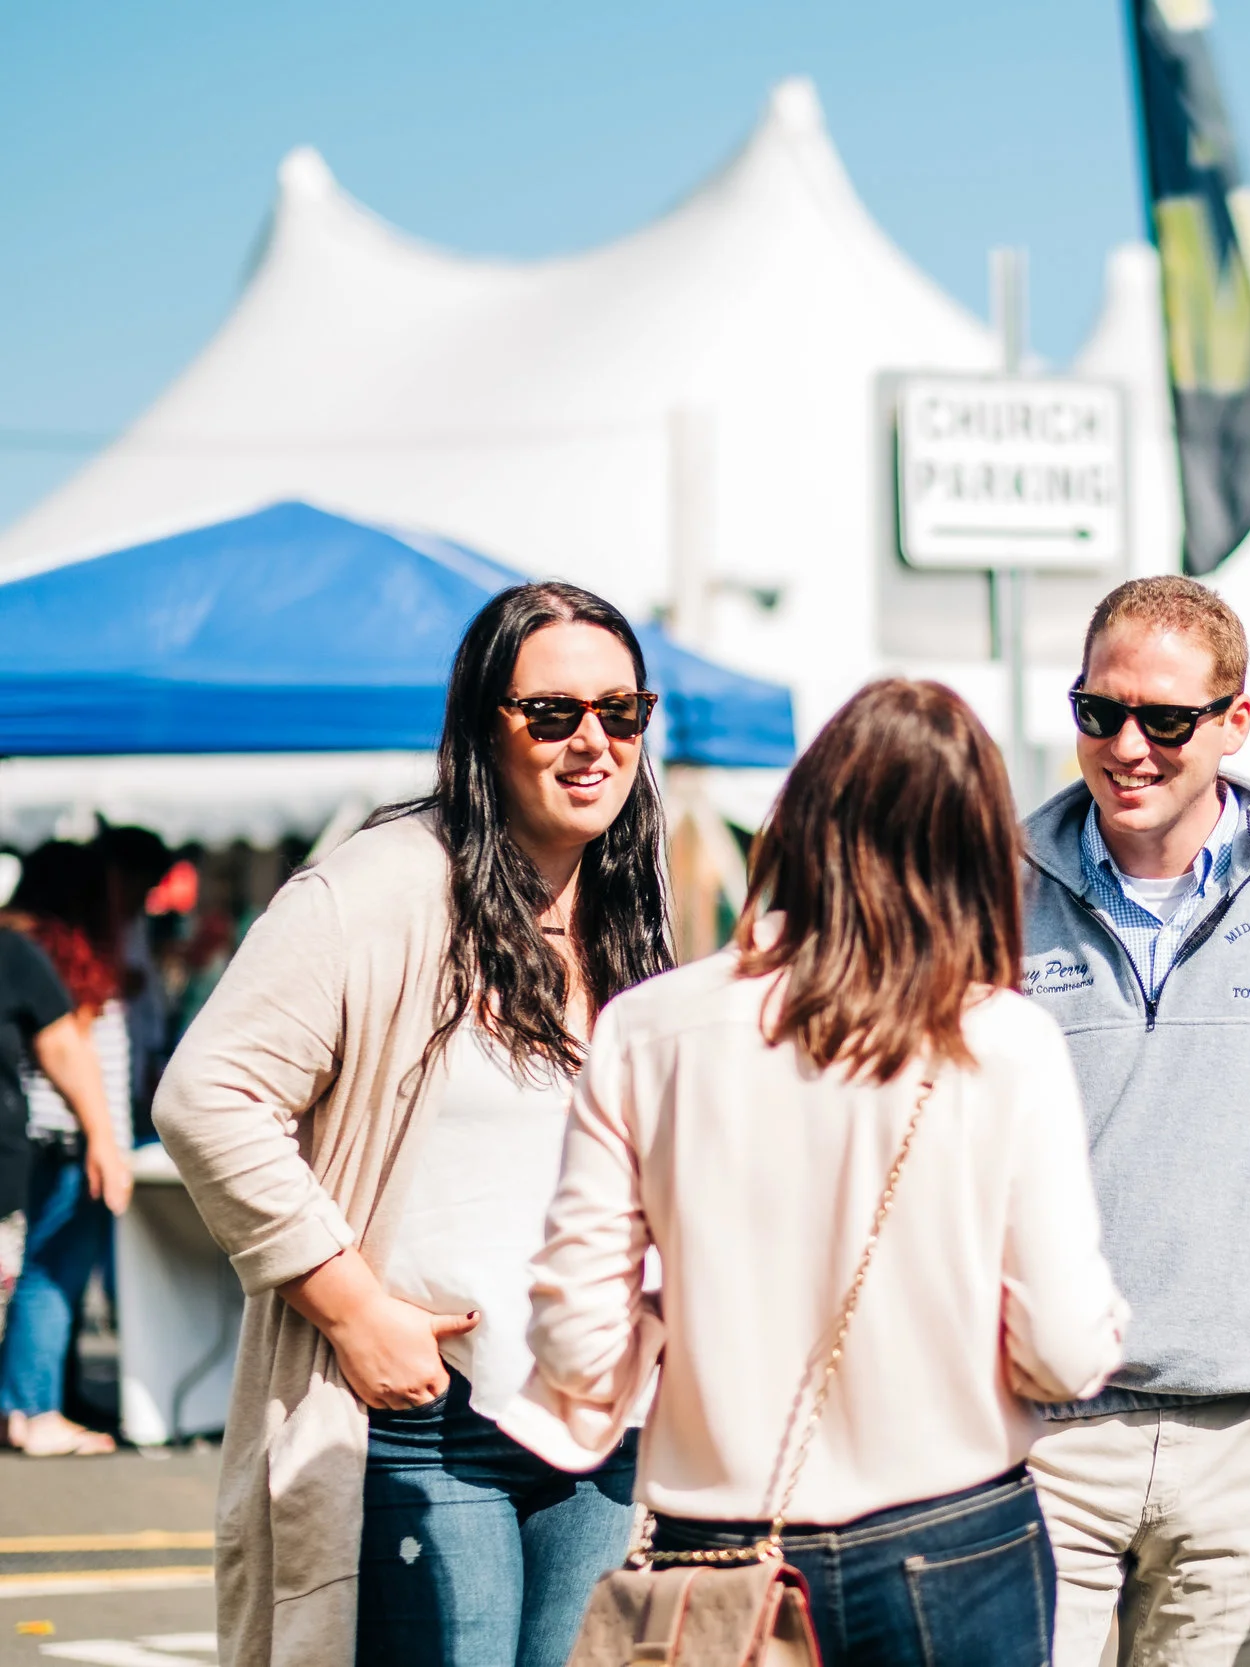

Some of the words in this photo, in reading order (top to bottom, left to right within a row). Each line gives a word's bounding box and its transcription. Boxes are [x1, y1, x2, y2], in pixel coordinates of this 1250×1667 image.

[917, 398, 1110, 443] CHURCH
[914, 460, 1114, 505] PARKING
[1045, 960, 1089, 979] Perry
